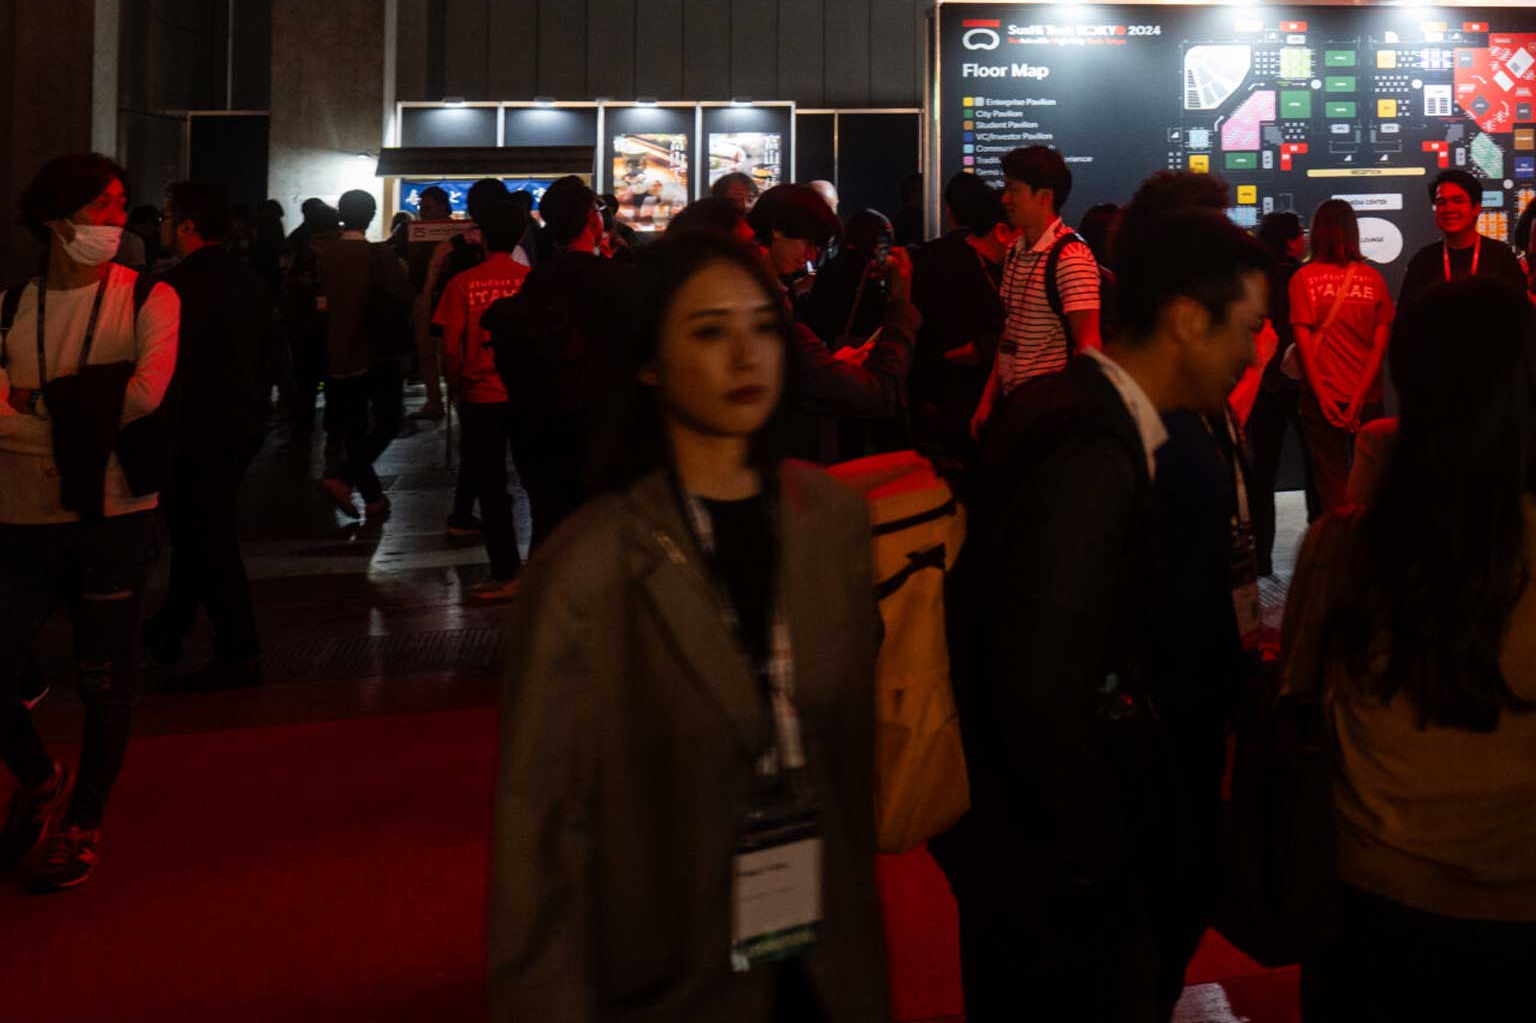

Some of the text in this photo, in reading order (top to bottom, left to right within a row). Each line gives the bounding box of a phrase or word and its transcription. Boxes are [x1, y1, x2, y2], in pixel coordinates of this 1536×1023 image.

[1128, 25, 1162, 36] 2024
[962, 63, 1049, 80] Floor Map
[986, 98, 1056, 107] Enterprise Pavilion
[975, 110, 1023, 119] City Pavilion
[975, 121, 1007, 129] Student
[975, 132, 1053, 142] VC/Investor Pavilion
